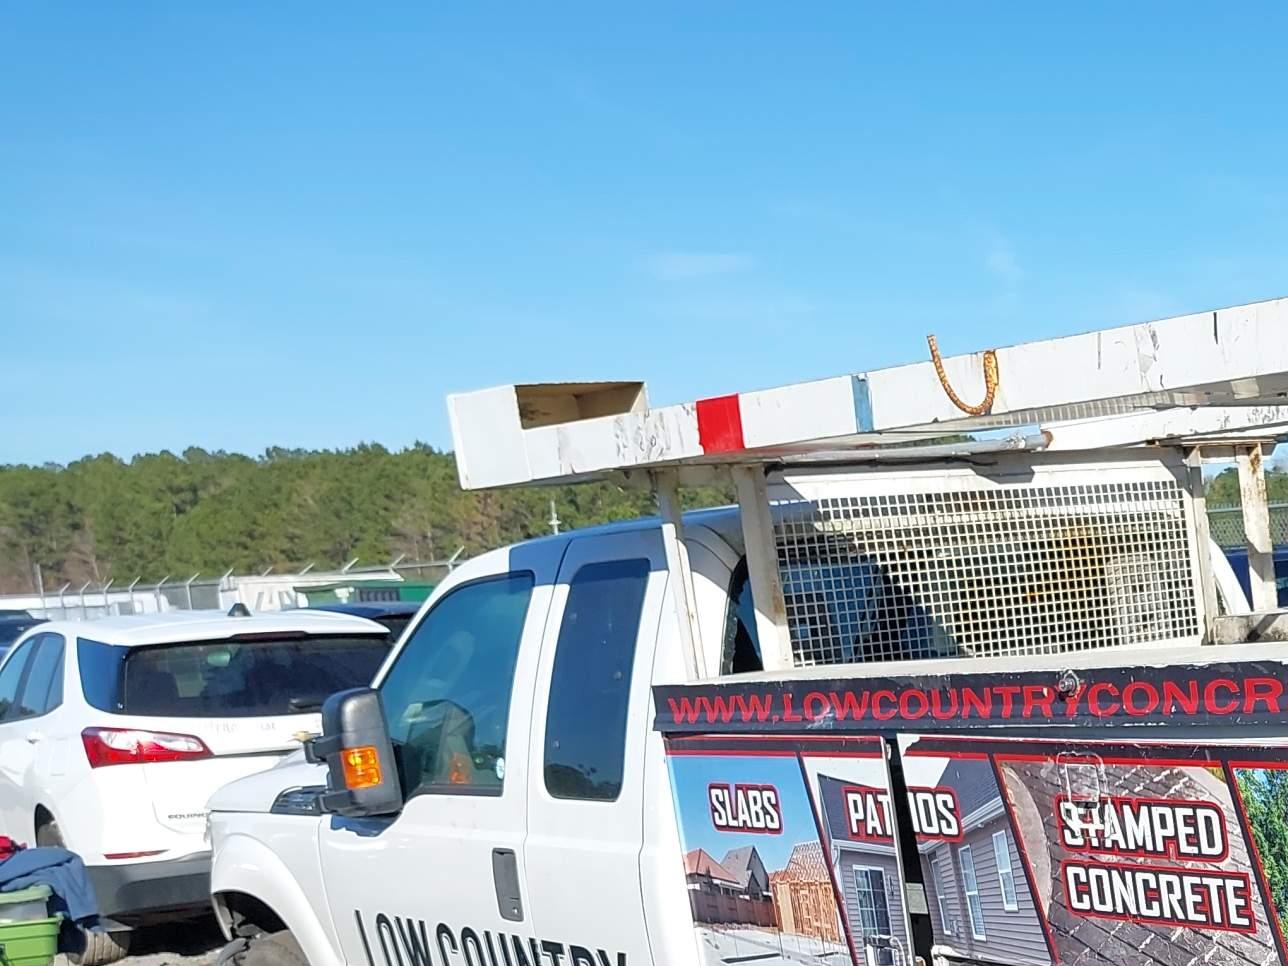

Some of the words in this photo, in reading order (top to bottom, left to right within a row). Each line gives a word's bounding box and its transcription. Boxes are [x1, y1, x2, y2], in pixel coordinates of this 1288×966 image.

[709, 788, 780, 829] SLABS
[847, 792, 959, 836] PATIOS
[1060, 801, 1224, 856] STAMPED
[1066, 865, 1250, 926] CONCRETE
